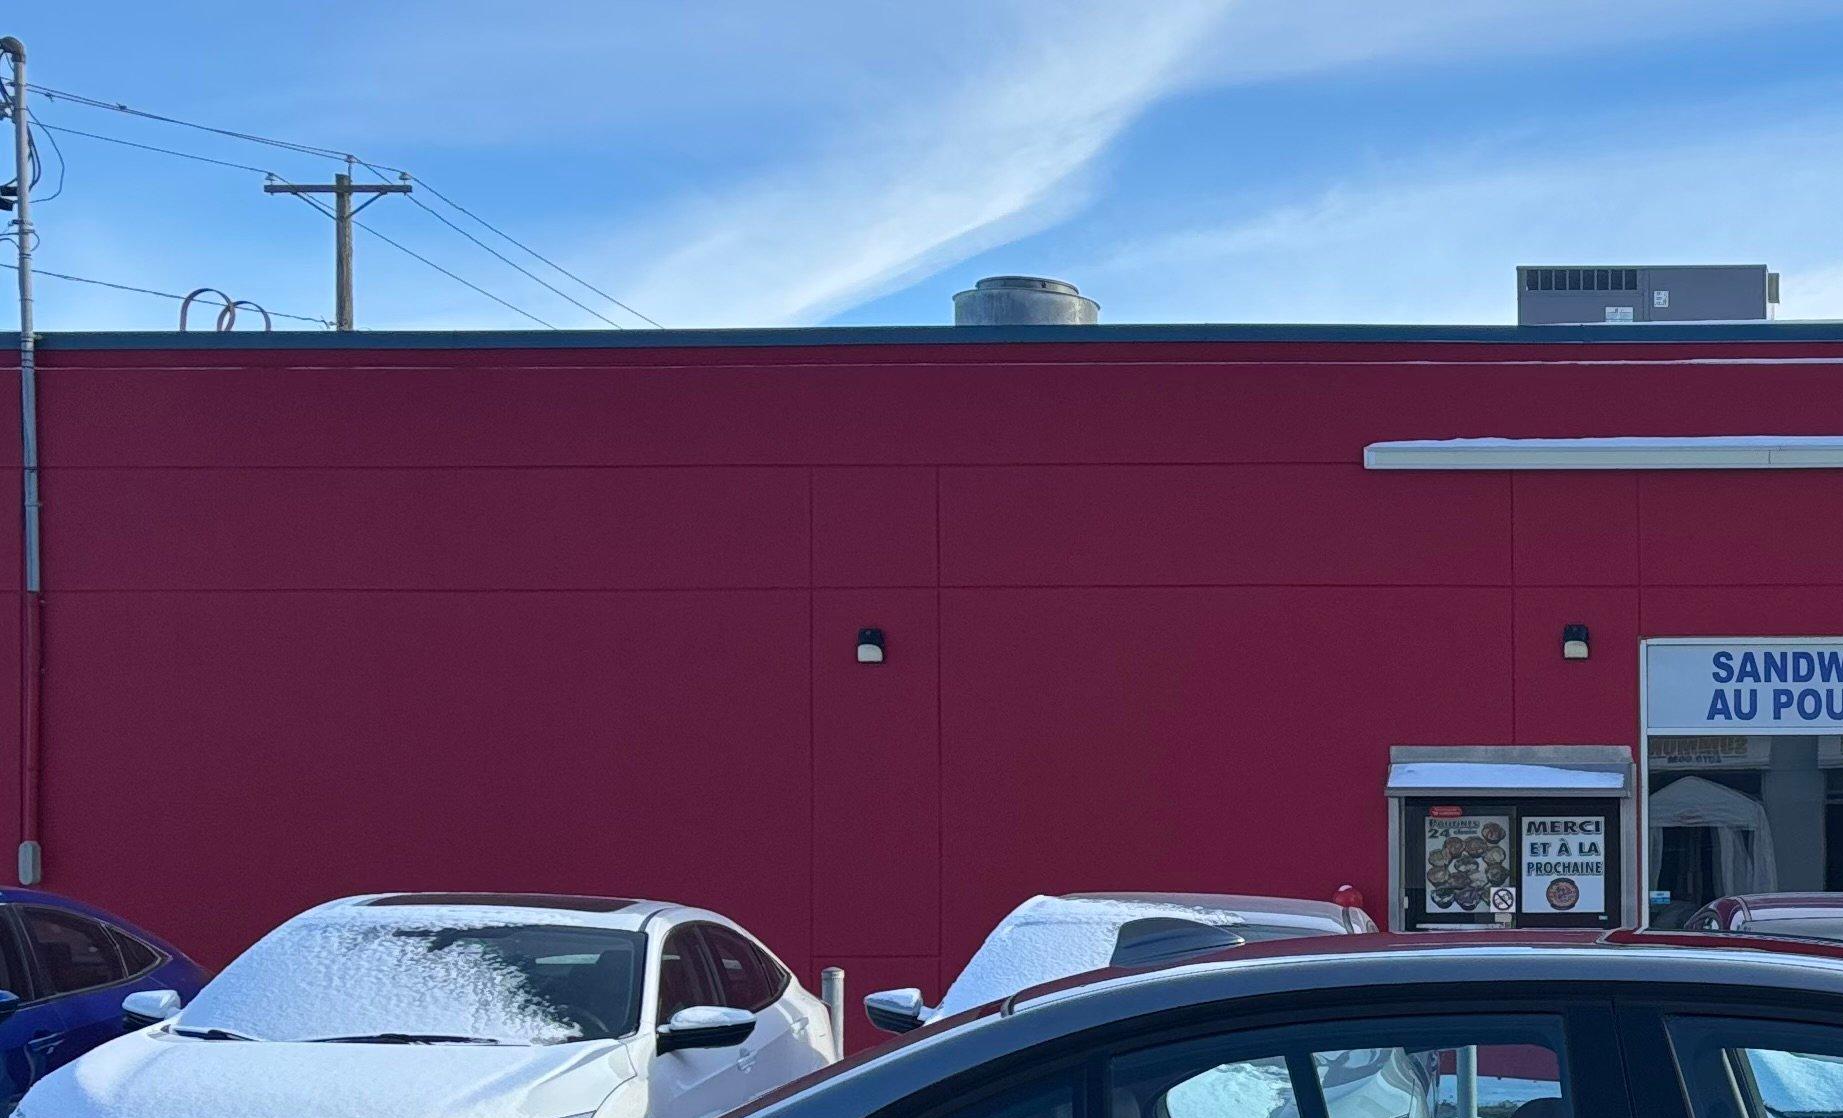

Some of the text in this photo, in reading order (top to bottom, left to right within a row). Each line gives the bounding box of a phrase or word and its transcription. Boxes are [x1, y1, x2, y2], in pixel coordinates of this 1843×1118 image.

[1706, 688, 1758, 721] AU
[1428, 829, 1451, 838] 24
[1525, 820, 1602, 836] MERCI
[1529, 838, 1601, 856] ET À LA
[1526, 861, 1604, 876] PROCHAINE
